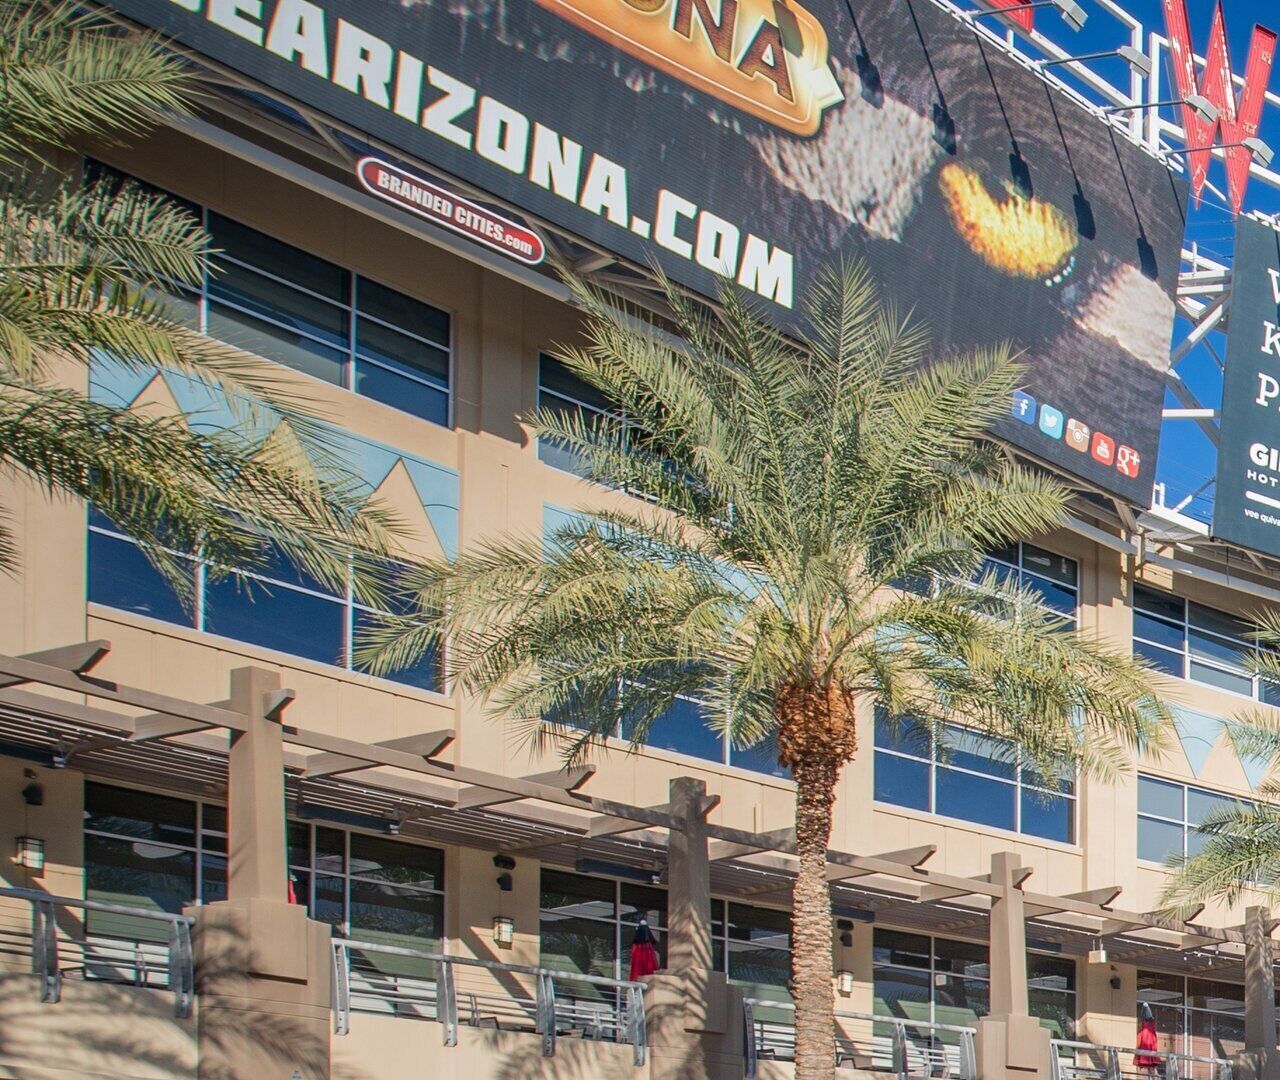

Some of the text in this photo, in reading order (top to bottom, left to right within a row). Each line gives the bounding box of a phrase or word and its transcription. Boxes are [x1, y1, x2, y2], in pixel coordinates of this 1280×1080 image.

[170, 0, 794, 309] EARIZONA.COM
[377, 169, 533, 256] BRANDED CITIES.com
[1244, 508, 1259, 520] vee
